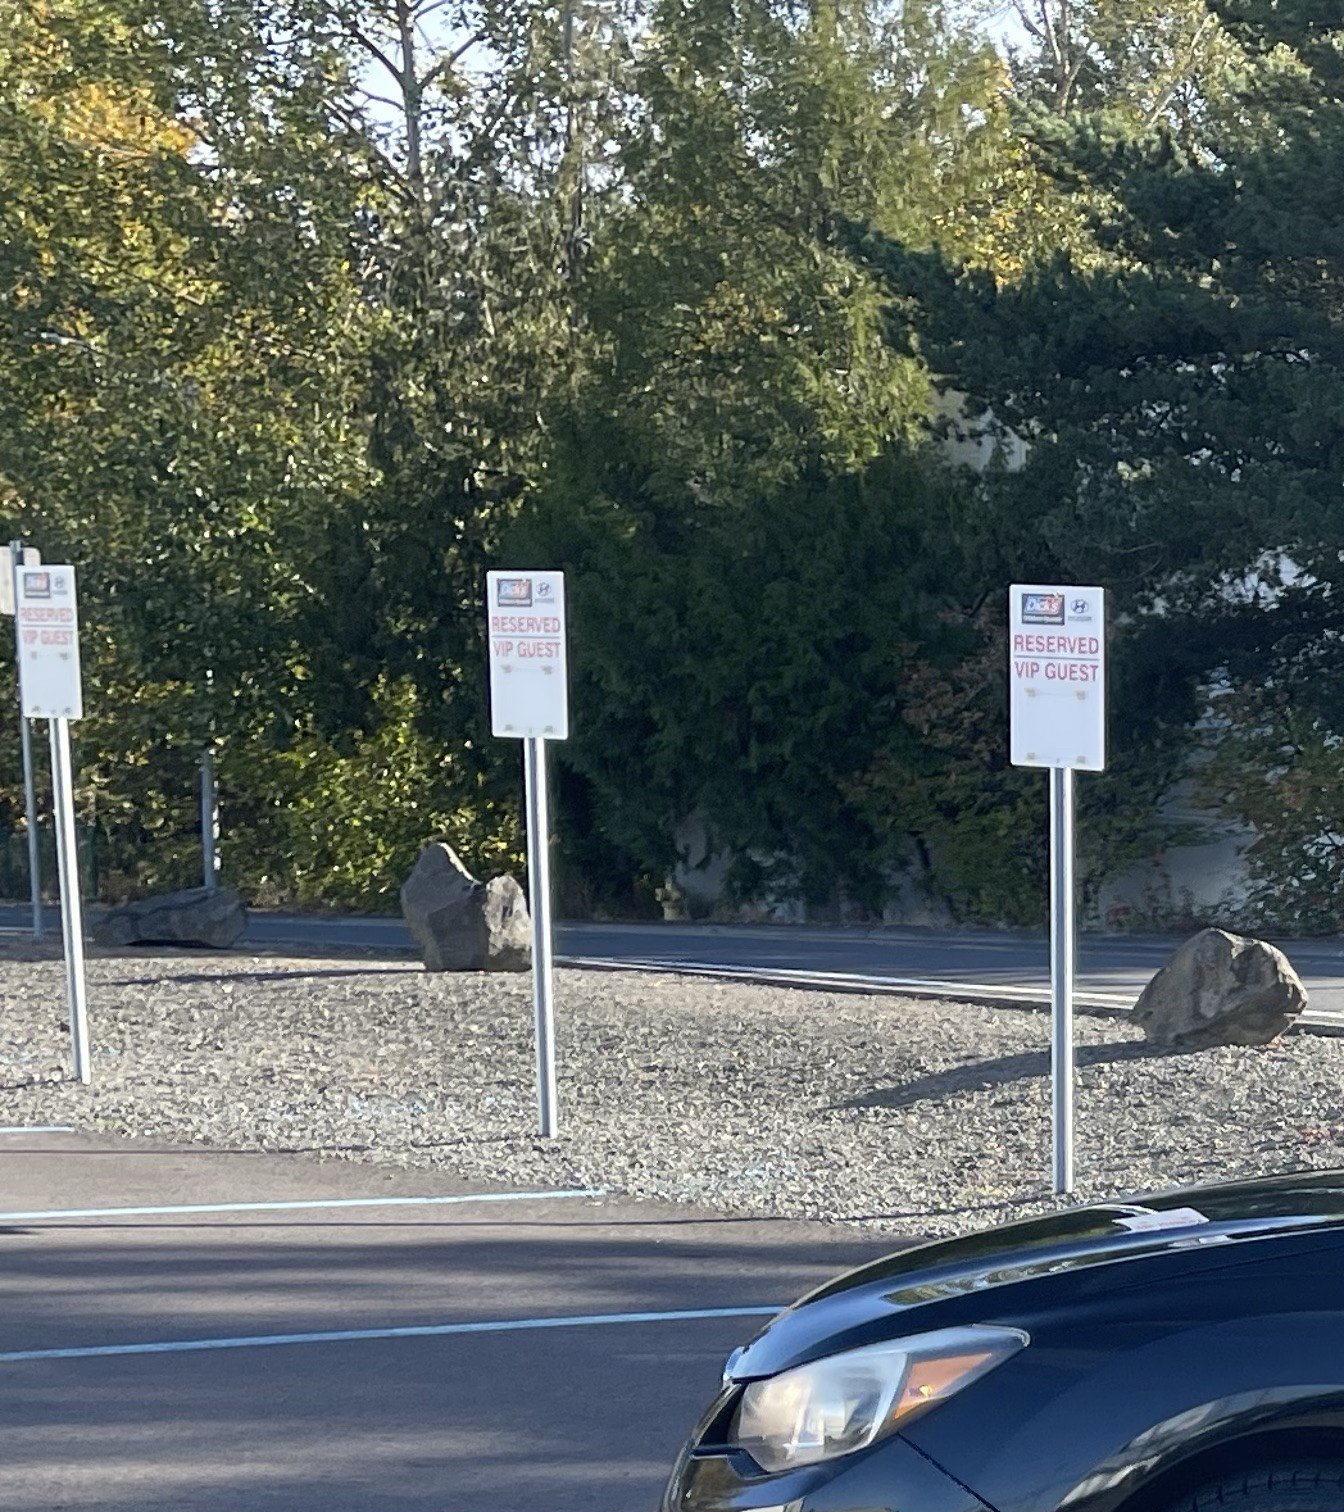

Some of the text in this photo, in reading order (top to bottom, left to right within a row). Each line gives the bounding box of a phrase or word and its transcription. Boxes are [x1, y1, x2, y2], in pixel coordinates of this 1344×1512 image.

[20, 606, 74, 623] RESERVED
[491, 616, 561, 634] RESERVED
[493, 641, 561, 659] VIP GUEST
[1013, 634, 1099, 655] RESERVED
[1014, 661, 1099, 682] VIP GUEST
